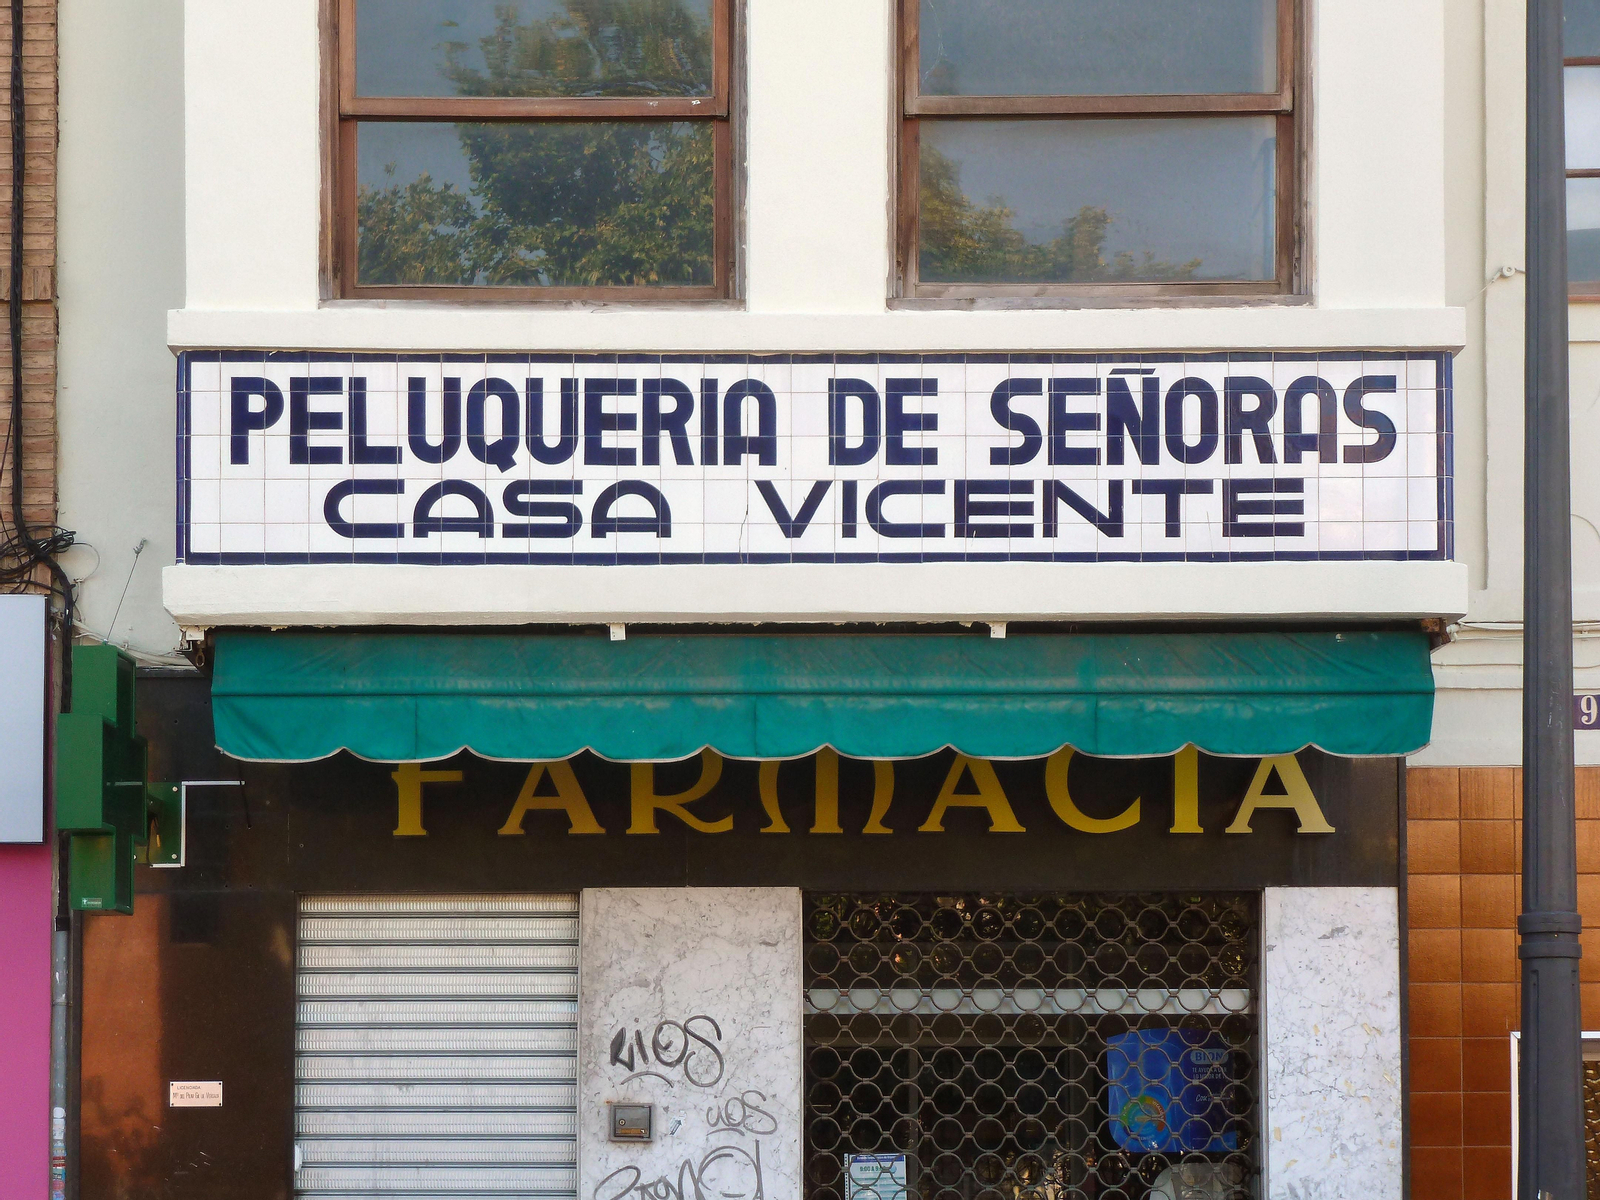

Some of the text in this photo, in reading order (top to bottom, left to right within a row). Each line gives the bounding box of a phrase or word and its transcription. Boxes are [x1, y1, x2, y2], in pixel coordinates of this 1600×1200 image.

[230, 368, 1398, 474] PELUQUERIA DE SEÑORAS
[323, 478, 1305, 539] CASA VICENTE
[1580, 695, 1599, 726] 9
[391, 744, 1336, 836] FARMACIA
